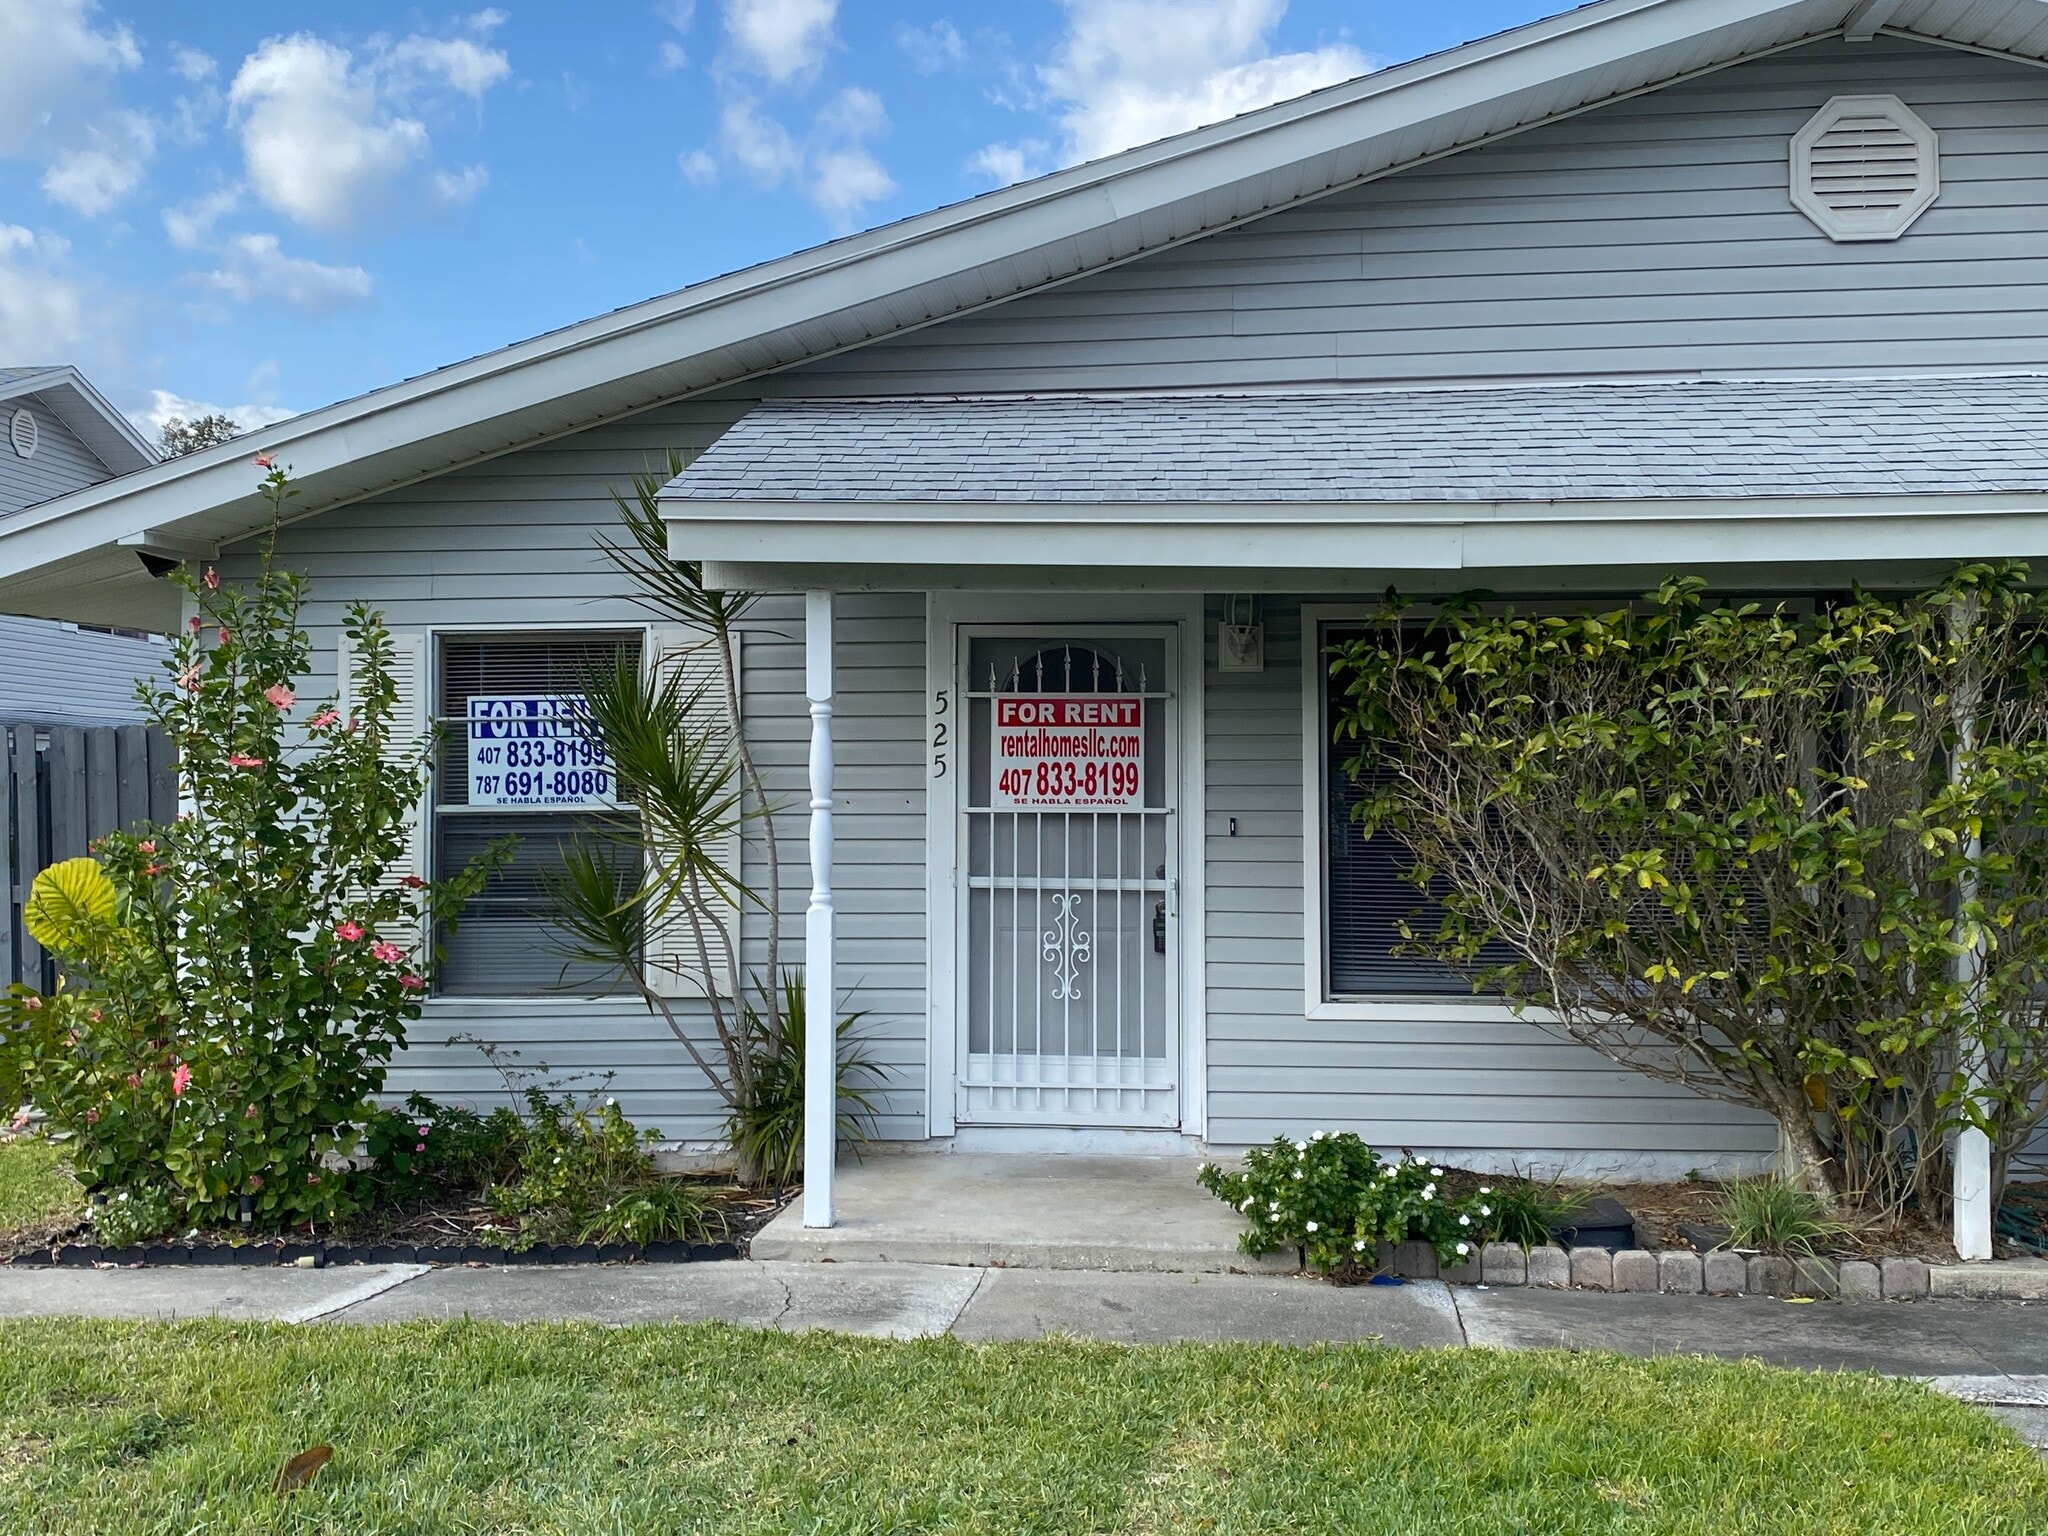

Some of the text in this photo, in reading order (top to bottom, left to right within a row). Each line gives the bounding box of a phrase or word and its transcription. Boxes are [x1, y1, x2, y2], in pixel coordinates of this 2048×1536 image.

[475, 702, 529, 737] FOR
[1003, 703, 1136, 723] FOR RENT
[477, 740, 605, 767] 407 833-8199
[1001, 728, 1139, 757] rentalhomesllc.com
[476, 771, 607, 795] 787 691-8080
[999, 762, 1138, 796] 407 833-8199
